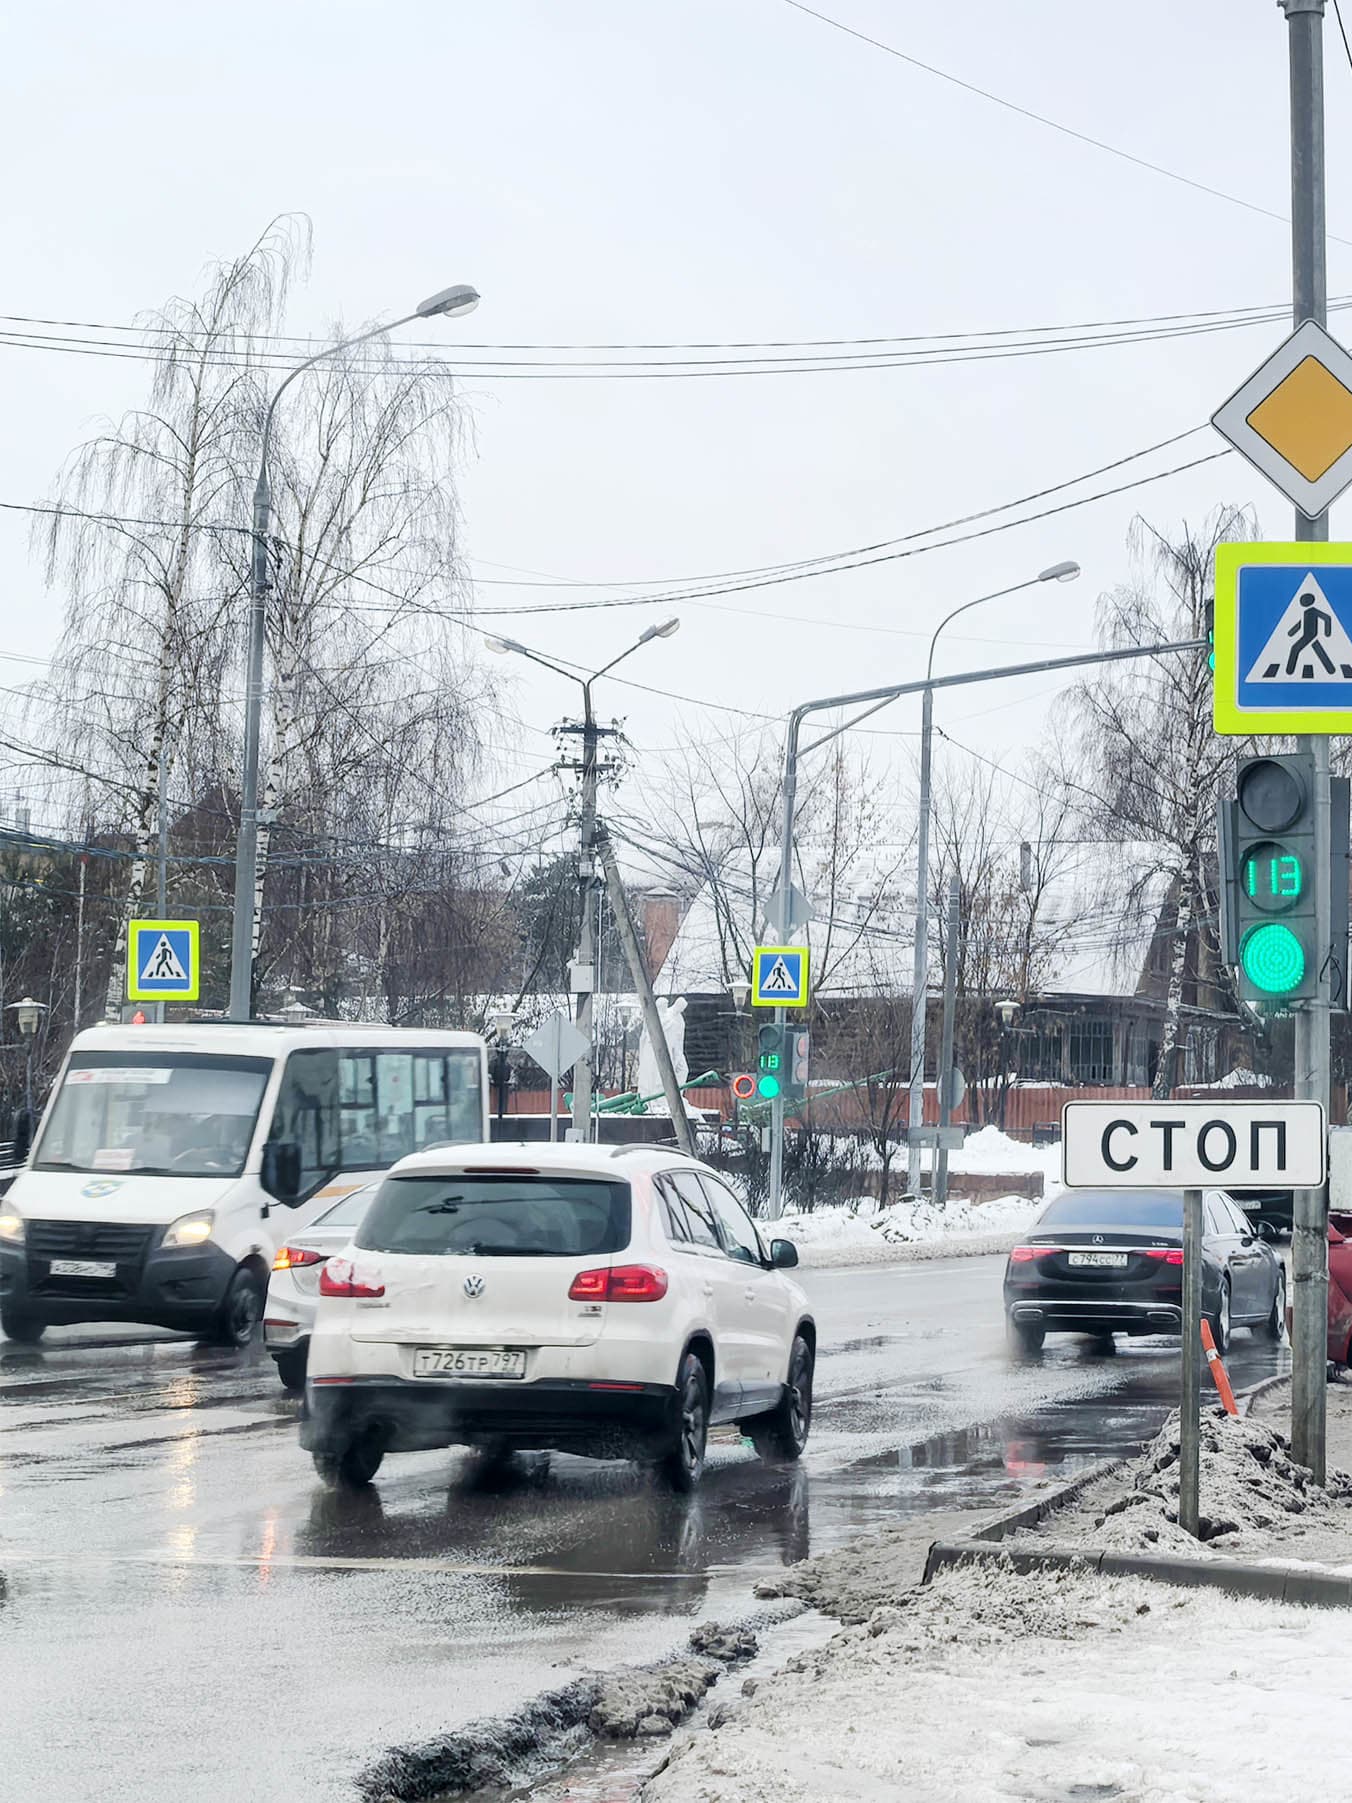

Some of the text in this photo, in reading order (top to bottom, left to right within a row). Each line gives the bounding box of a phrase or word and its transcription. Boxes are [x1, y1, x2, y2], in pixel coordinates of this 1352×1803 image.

[1248, 855, 1301, 897] 113
[1100, 1119, 1288, 1172] СТОП
[492, 1353, 520, 1367] 797
